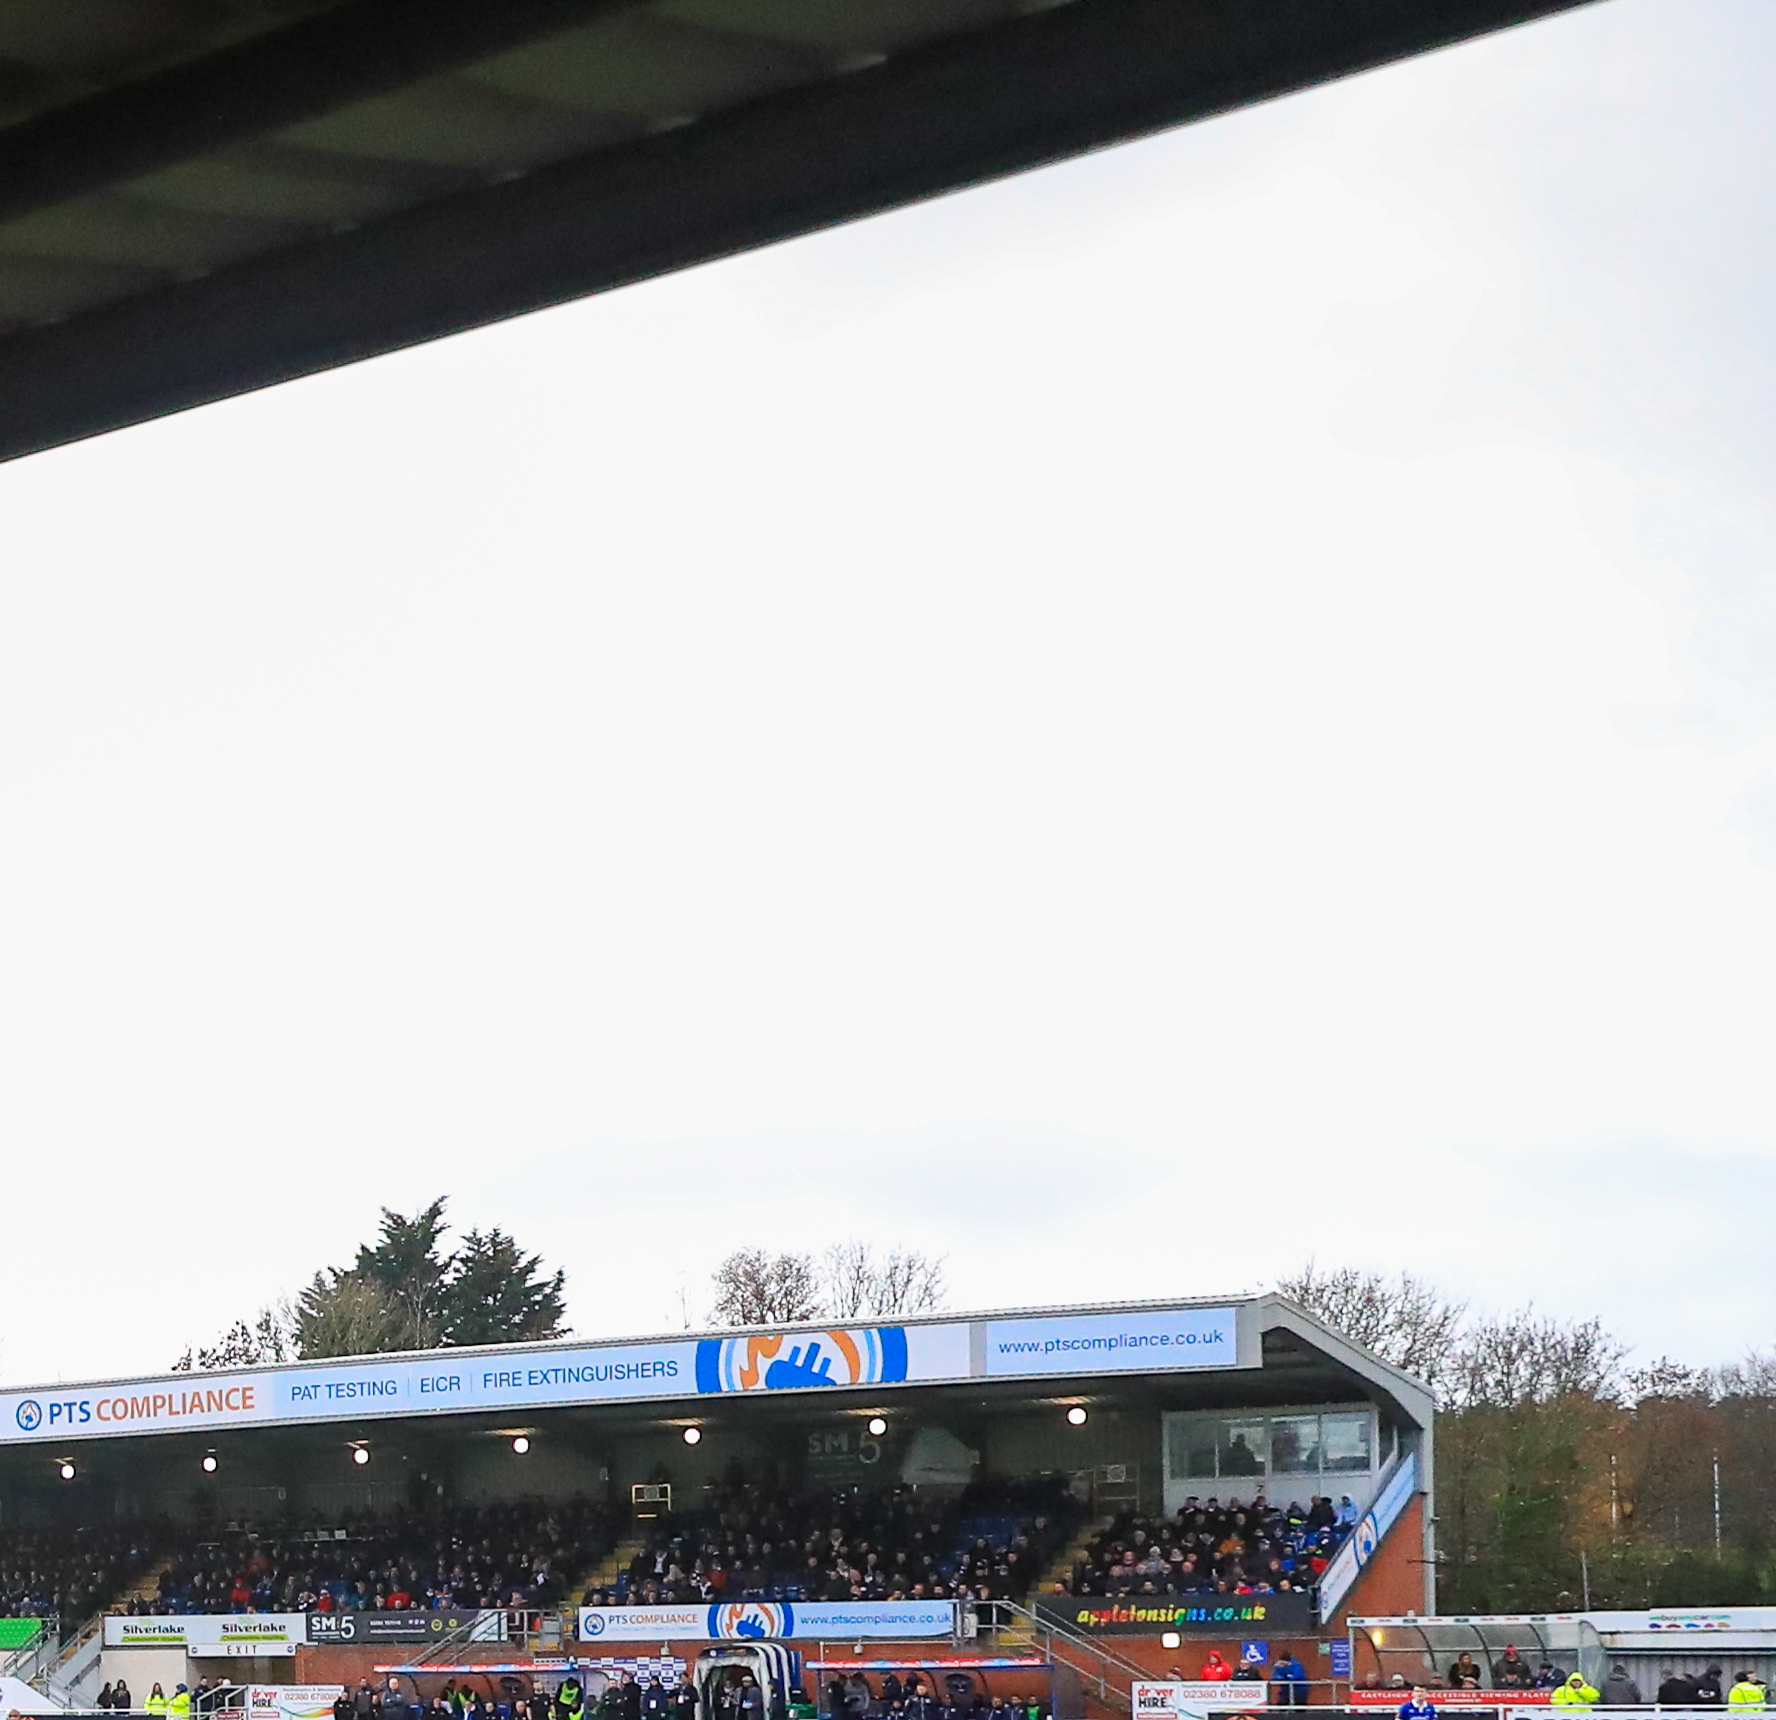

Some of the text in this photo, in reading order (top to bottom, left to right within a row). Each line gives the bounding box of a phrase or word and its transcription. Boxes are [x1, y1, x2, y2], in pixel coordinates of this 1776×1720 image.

[999, 1329, 1224, 1355] www.ptscompliance.co.uk
[291, 1360, 679, 1401] PAT TESTING EICR FIRE EXTINGUISHERS
[49, 1387, 255, 1425] PTS COMPLIANCE
[609, 1613, 951, 1628] PTS COMPLIANCE www.ptscompliance.co.uk
[1076, 1603, 1267, 1626] appletonsigns.co.uk
[123, 1625, 185, 1634] Silverlake
[222, 1623, 287, 1632] Silverlake
[227, 1645, 256, 1655] EXIT
[1184, 1689, 1217, 1699] 02380
[1139, 1697, 1166, 1708] HIRE
